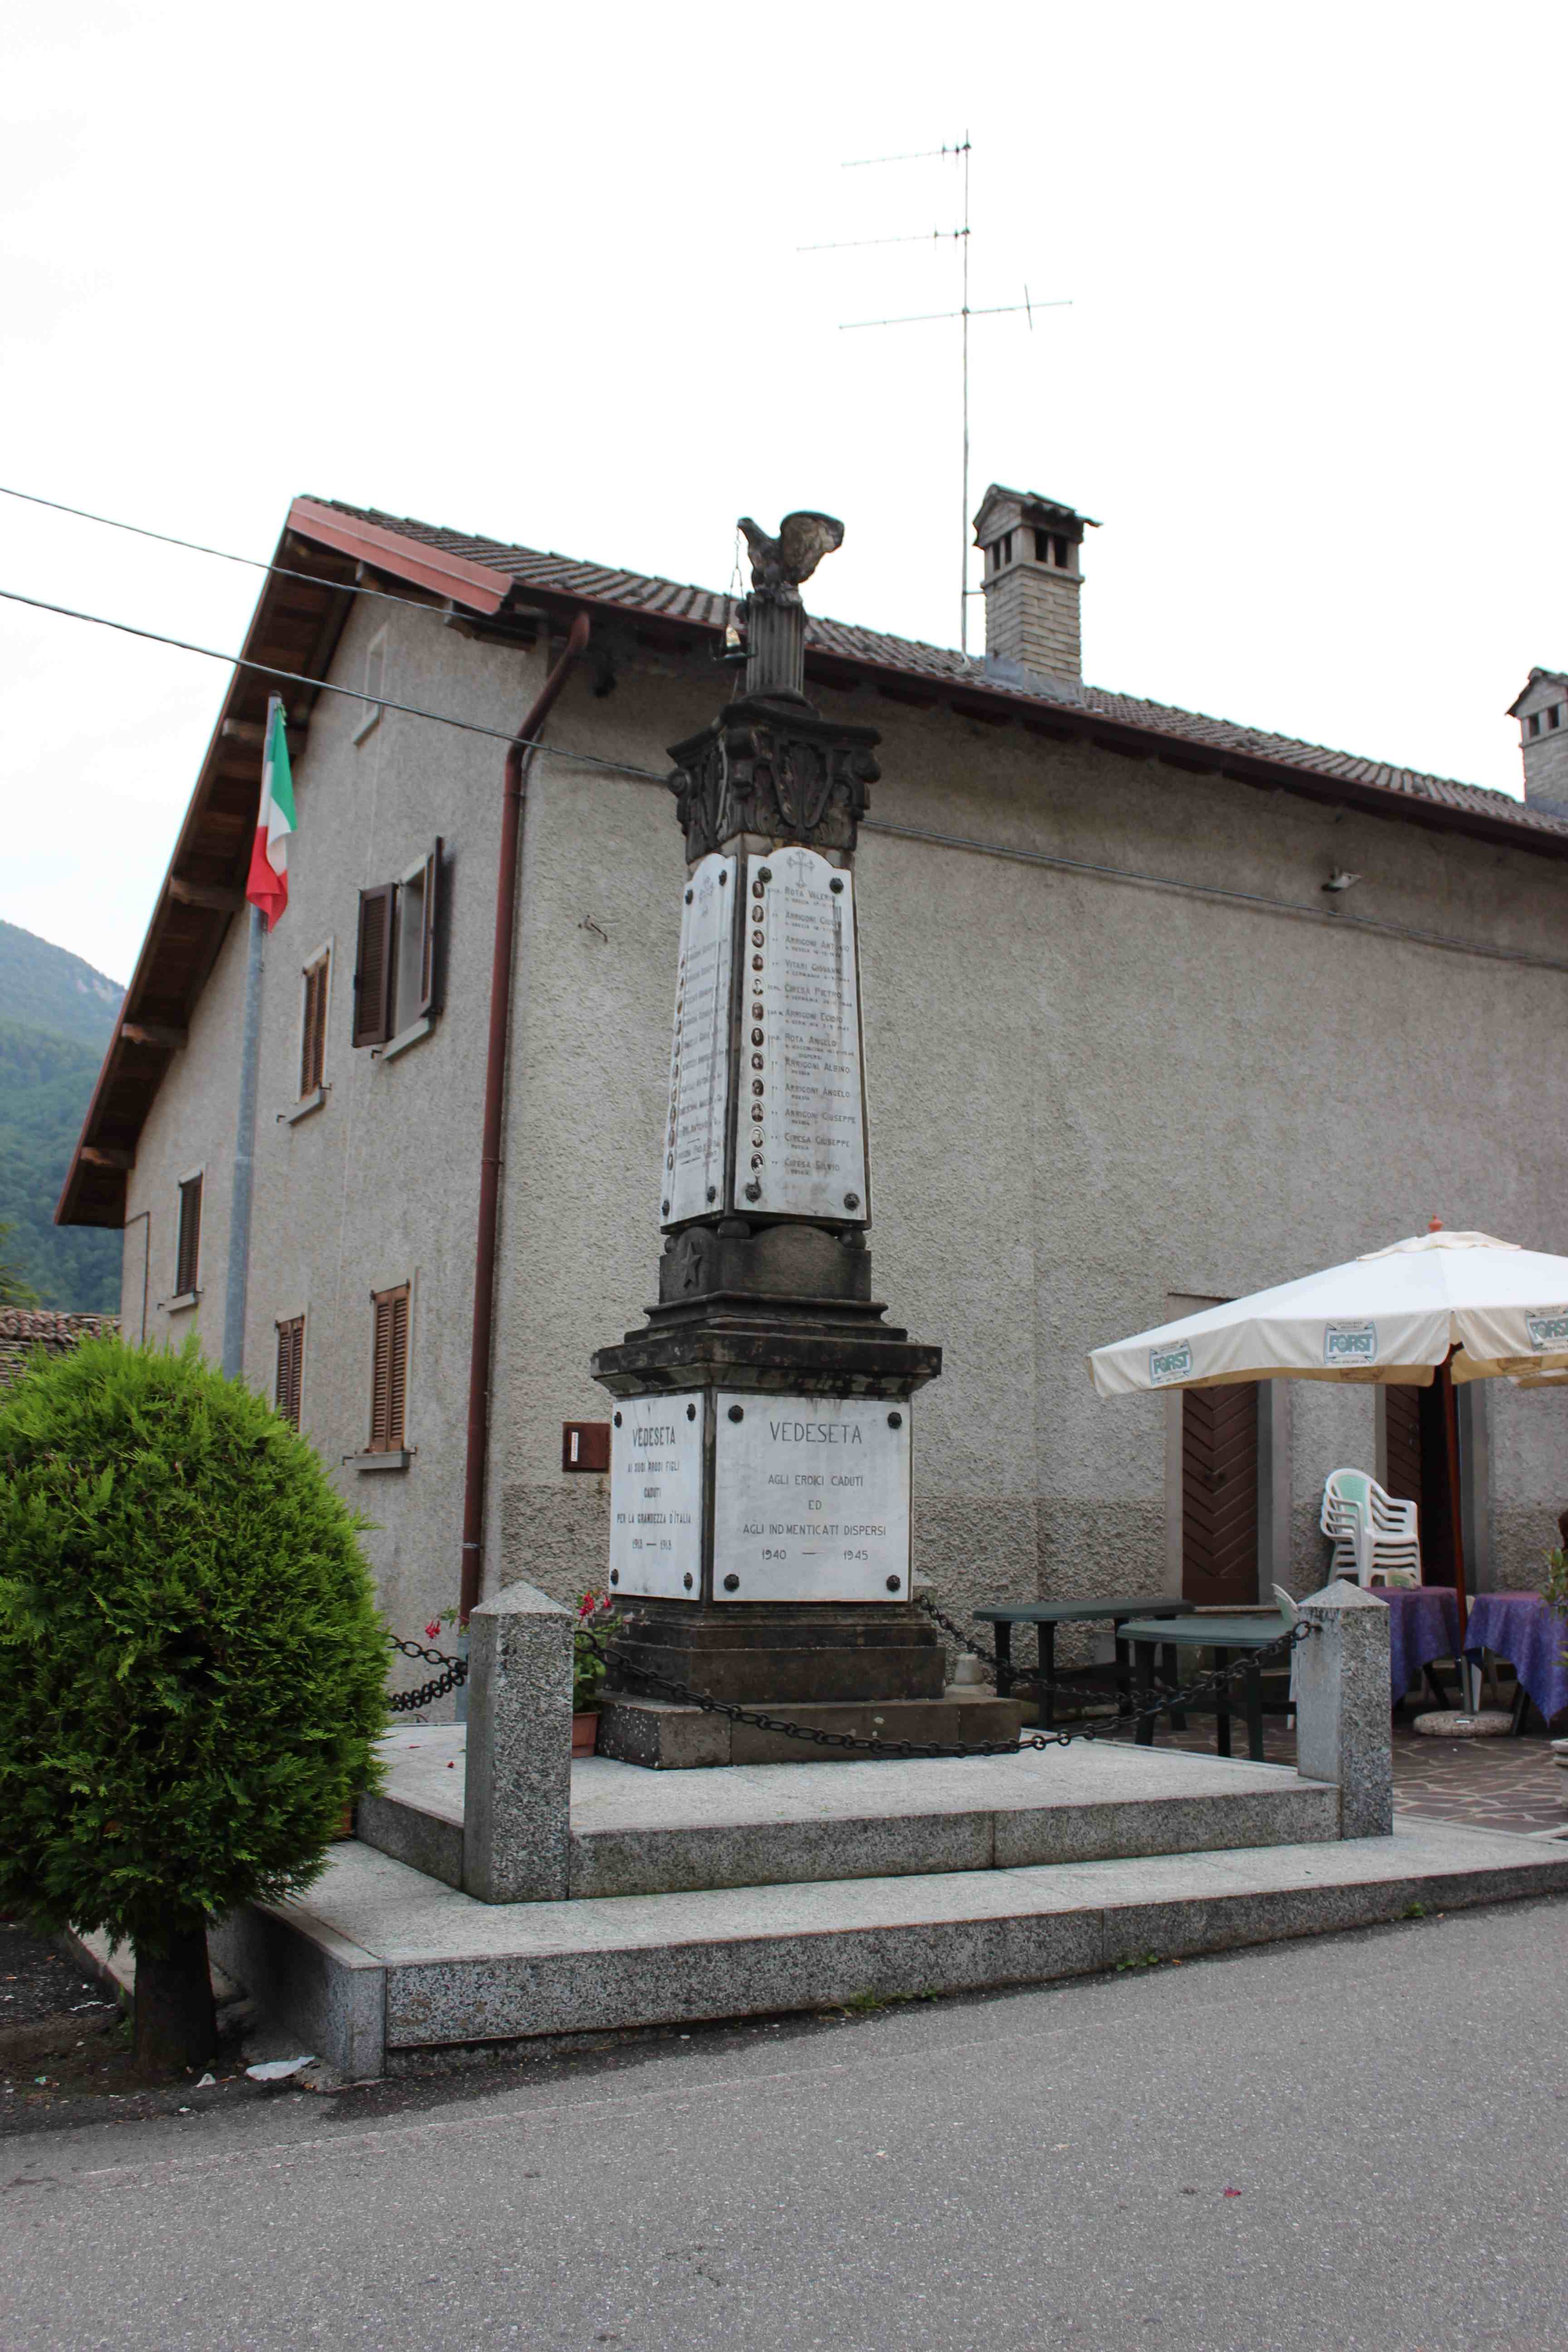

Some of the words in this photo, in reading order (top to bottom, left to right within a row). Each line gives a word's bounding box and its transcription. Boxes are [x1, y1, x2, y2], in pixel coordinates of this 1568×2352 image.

[785, 1033, 804, 1043] ROTA
[809, 1036, 836, 1047] ANGELO
[785, 1058, 819, 1070] ARRIGONI
[824, 1062, 850, 1073] ALBINO
[785, 1083, 818, 1095] ARRIGONI
[823, 1087, 850, 1098] ANGELO
[785, 1108, 818, 1119] ARRIGONI
[822, 1112, 856, 1124] GIUSEPPE
[1329, 1334, 1372, 1352] FORST
[1153, 1351, 1189, 1374] FORST
[632, 1426, 676, 1447] VEDESETA
[769, 1421, 862, 1444] VEDESETA
[666, 1460, 680, 1472] FIGLI
[768, 1475, 789, 1485] AGLI
[795, 1475, 824, 1486] EROICI
[831, 1475, 863, 1487] CADUTI
[808, 1499, 822, 1510] ED
[617, 1513, 626, 1524] PER
[628, 1514, 634, 1524] LA
[637, 1513, 666, 1524] GRANDEZZA
[742, 1524, 764, 1535] AGLI
[843, 1525, 886, 1536] DISPERSI
[761, 1549, 787, 1560] 1940
[843, 1550, 868, 1560] 1945
